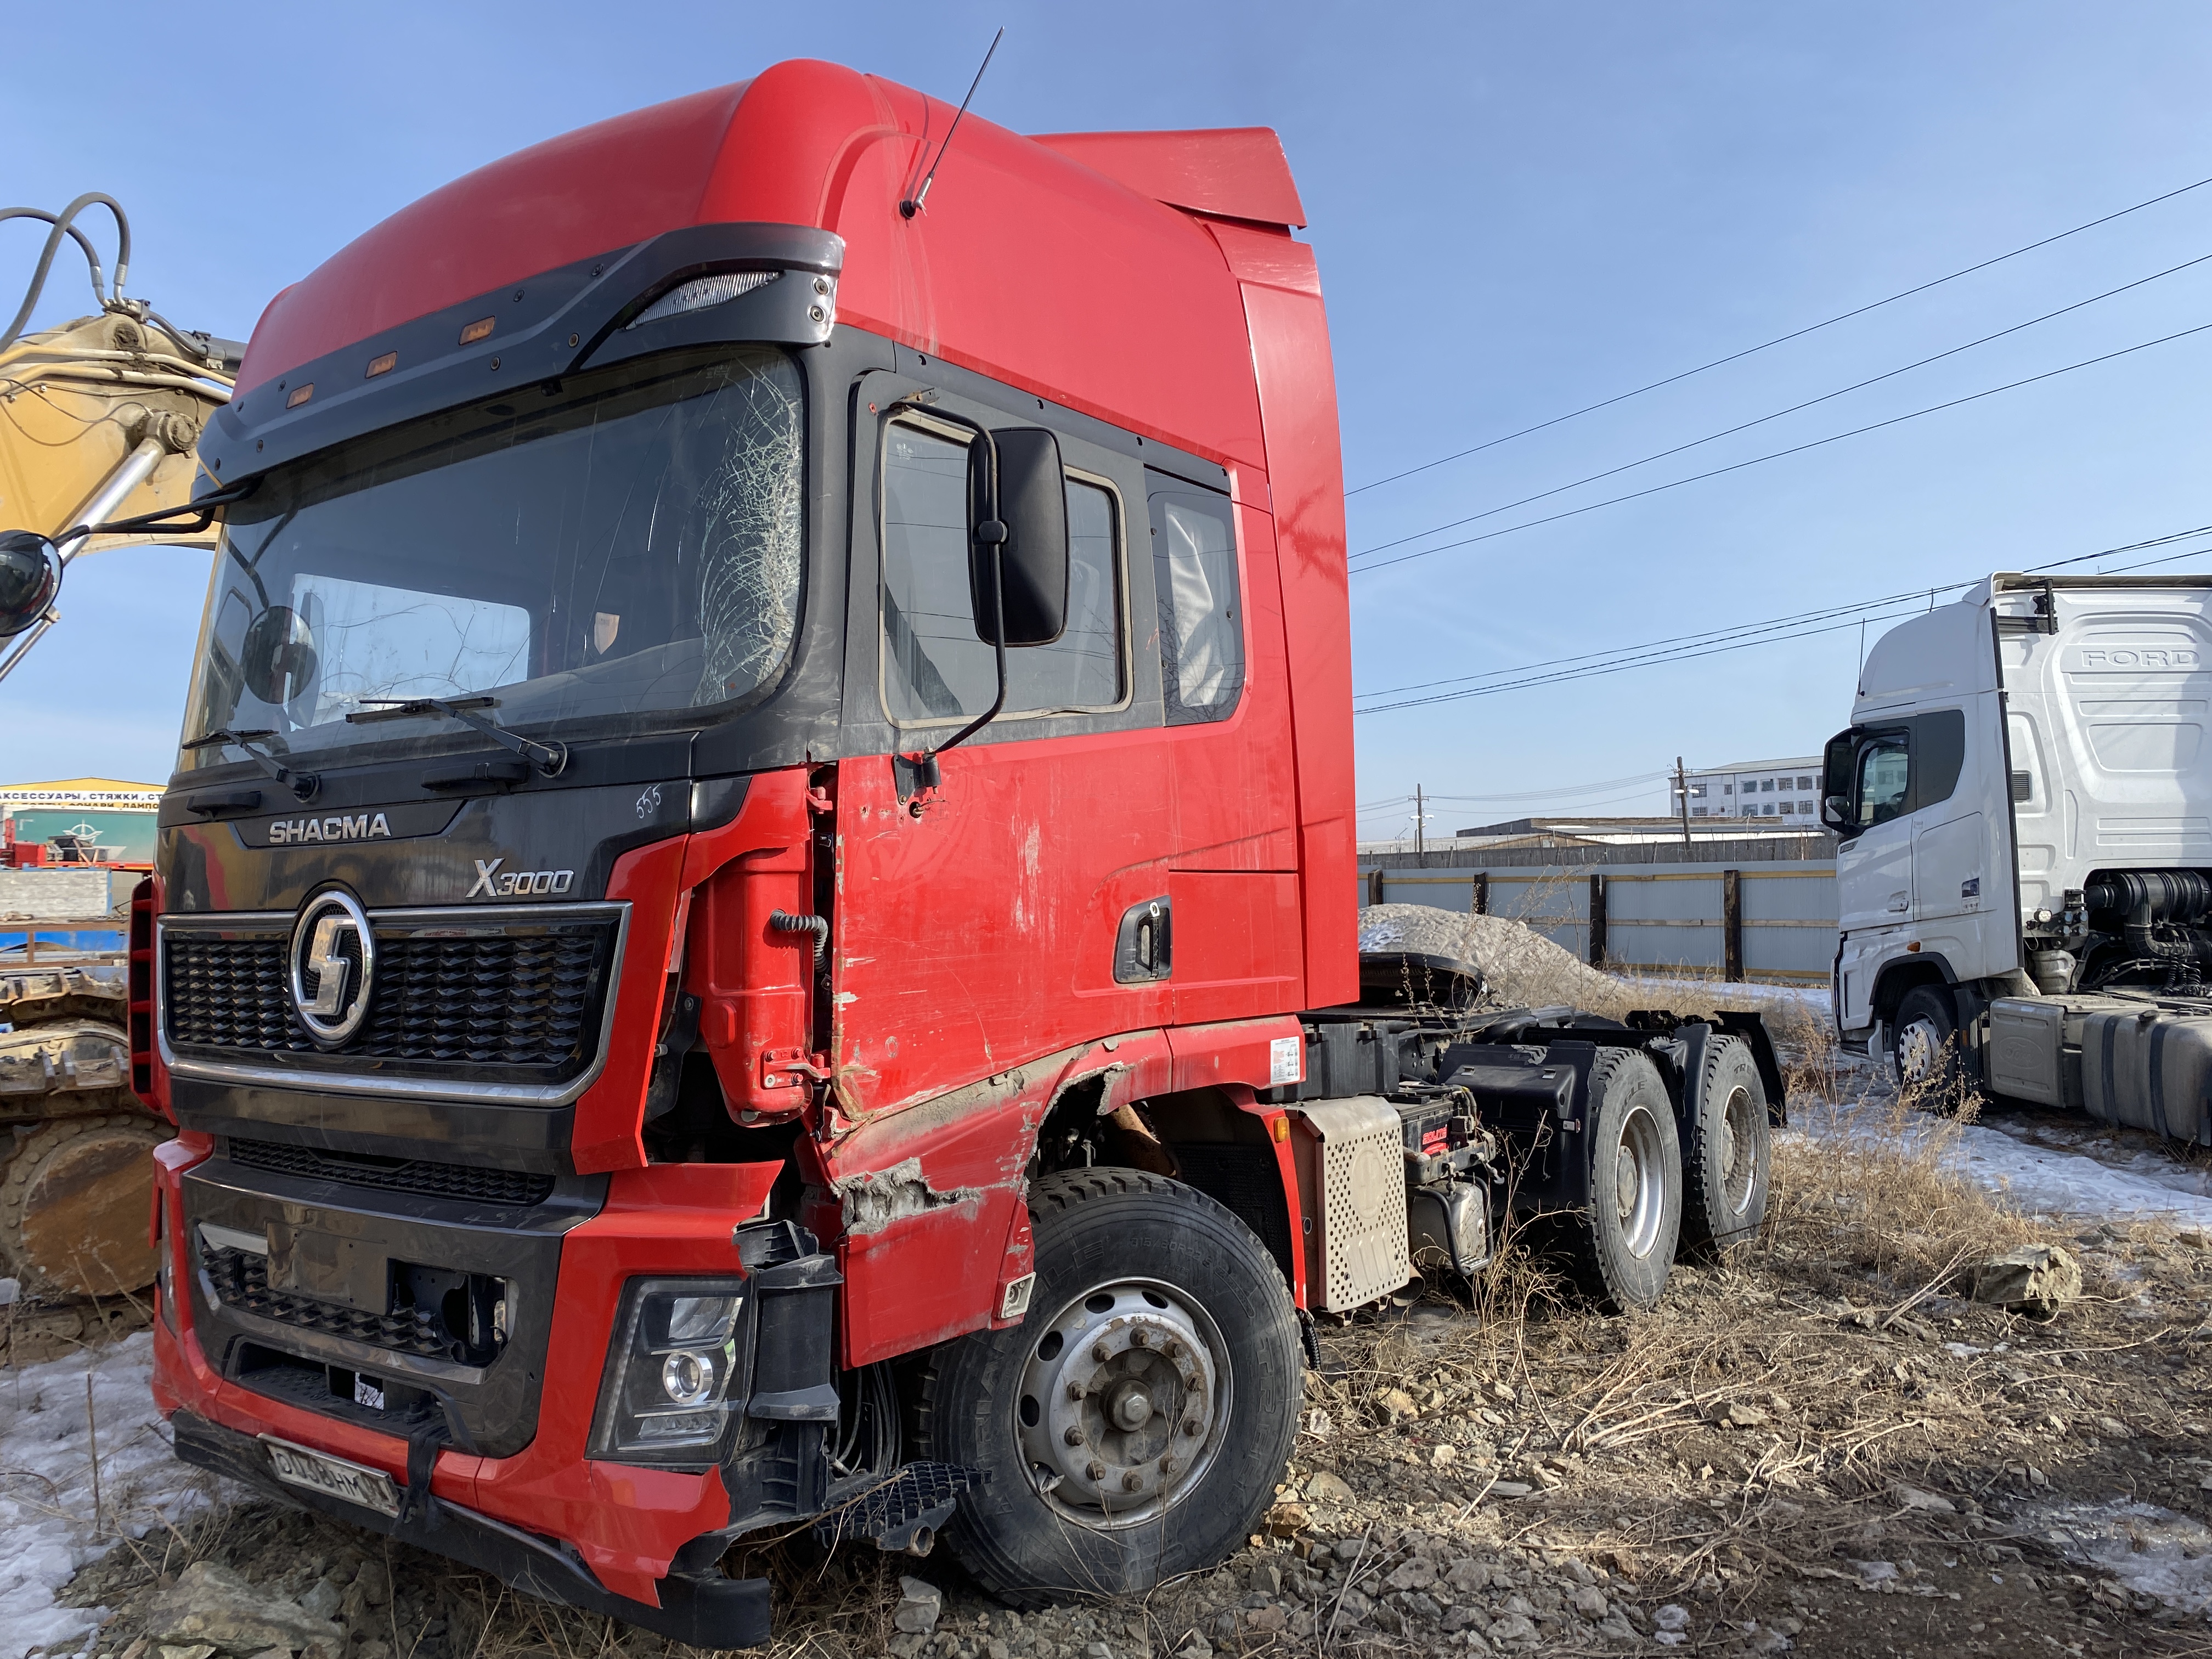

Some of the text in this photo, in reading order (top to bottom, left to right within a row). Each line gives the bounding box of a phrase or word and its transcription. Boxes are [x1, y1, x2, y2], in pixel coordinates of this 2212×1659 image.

[2081, 650, 2199, 667] FORD
[636, 783, 662, 819] 555
[269, 812, 391, 844] SHACMA
[465, 857, 575, 898] X3000
